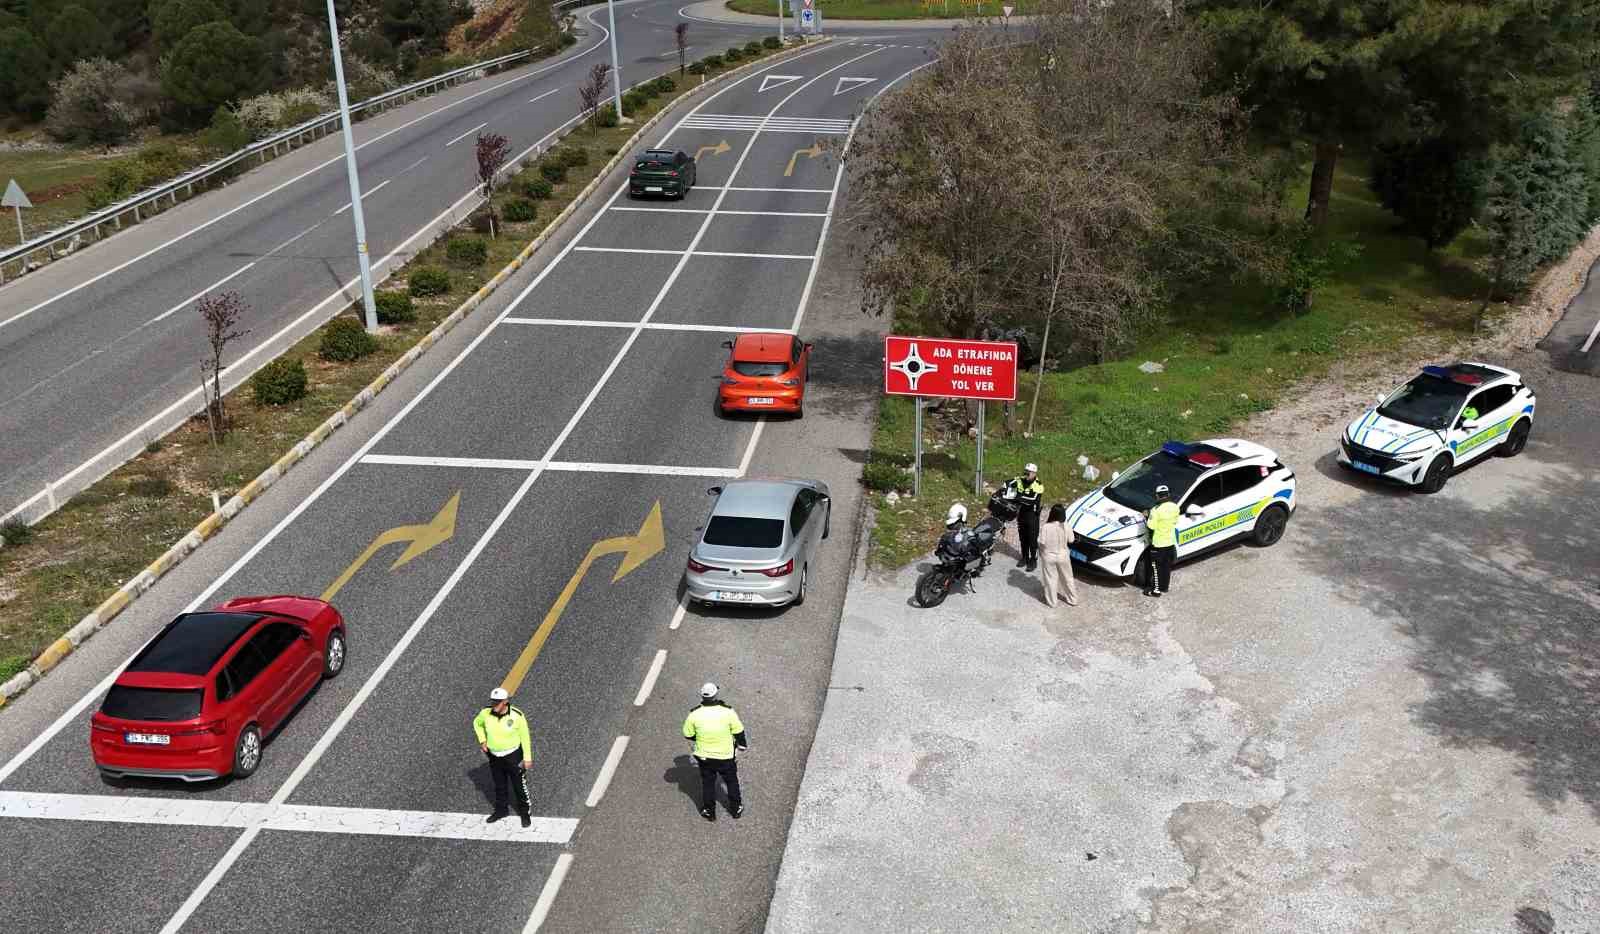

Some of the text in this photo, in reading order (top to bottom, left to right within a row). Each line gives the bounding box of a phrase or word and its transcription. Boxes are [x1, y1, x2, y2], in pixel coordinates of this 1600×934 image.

[933, 348, 1012, 360] ADA ETRAFINDA
[952, 380, 995, 391] YOL VER
